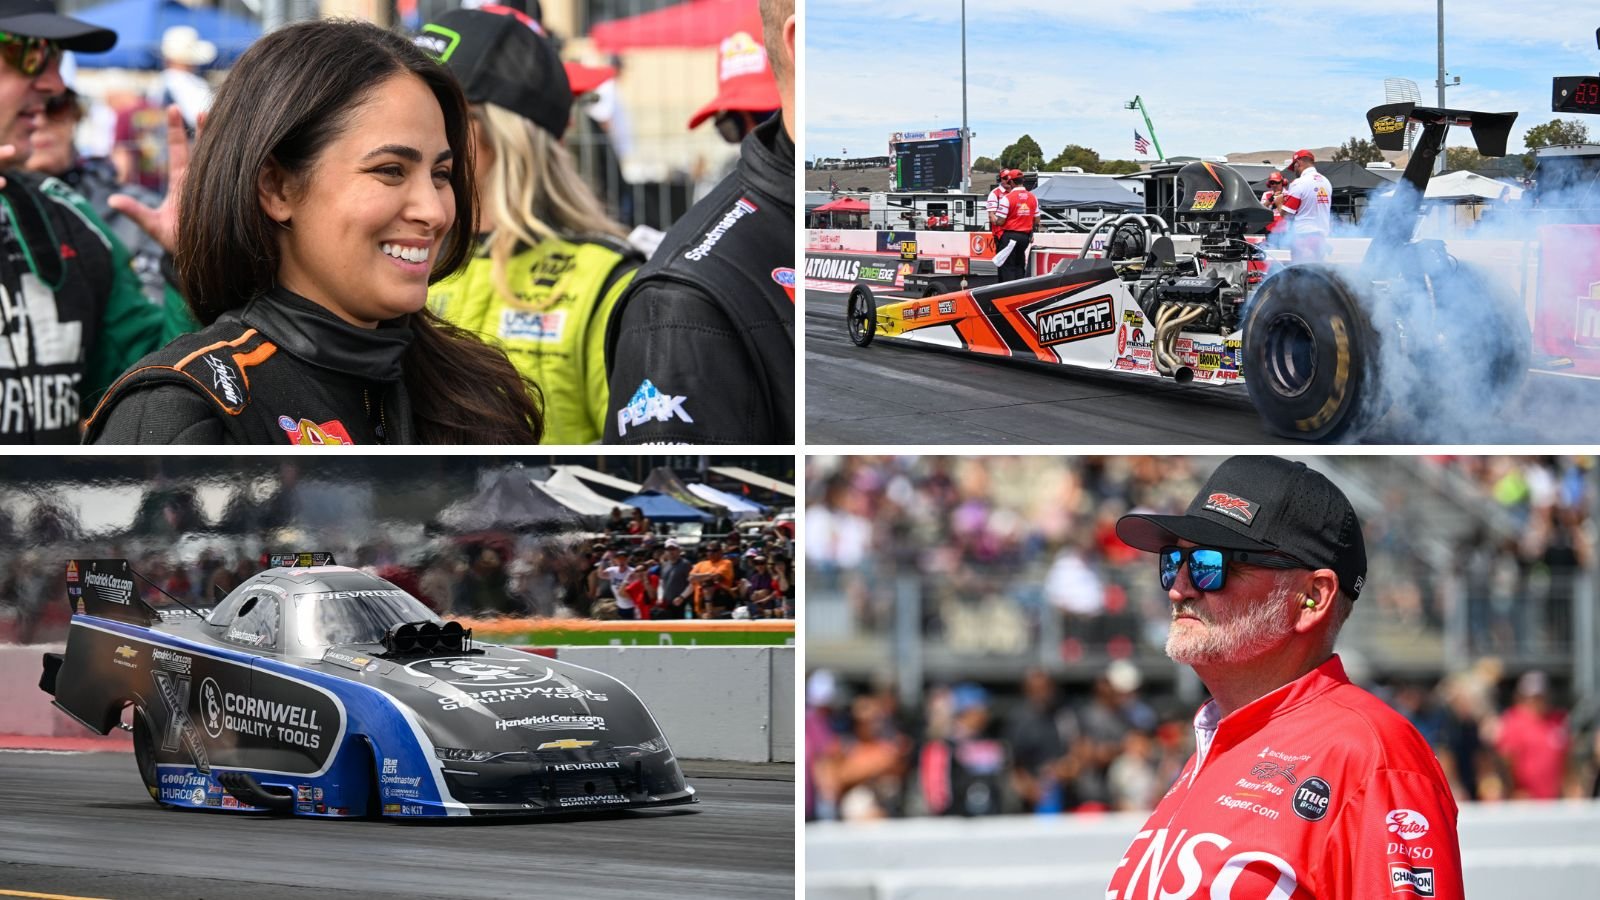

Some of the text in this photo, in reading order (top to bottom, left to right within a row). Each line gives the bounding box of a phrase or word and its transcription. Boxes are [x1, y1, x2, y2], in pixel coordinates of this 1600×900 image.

[684, 205, 747, 261] Speedmaster
[1039, 302, 1111, 335] MADCAP
[1041, 321, 1112, 342] RACING ENGINES
[618, 395, 694, 437] PEAK
[113, 658, 138, 669] CHEVROLET
[225, 692, 320, 731] CORNWELL
[225, 715, 321, 749] QUALITY TOOLS
[546, 761, 620, 772] HEVROLET
[162, 787, 193, 800] HURCO
[1298, 787, 1329, 808] True
[1300, 801, 1323, 815] Brand
[1387, 812, 1428, 834] Gates
[1387, 842, 1434, 860] DENSO
[1105, 828, 1298, 900] ENSO
